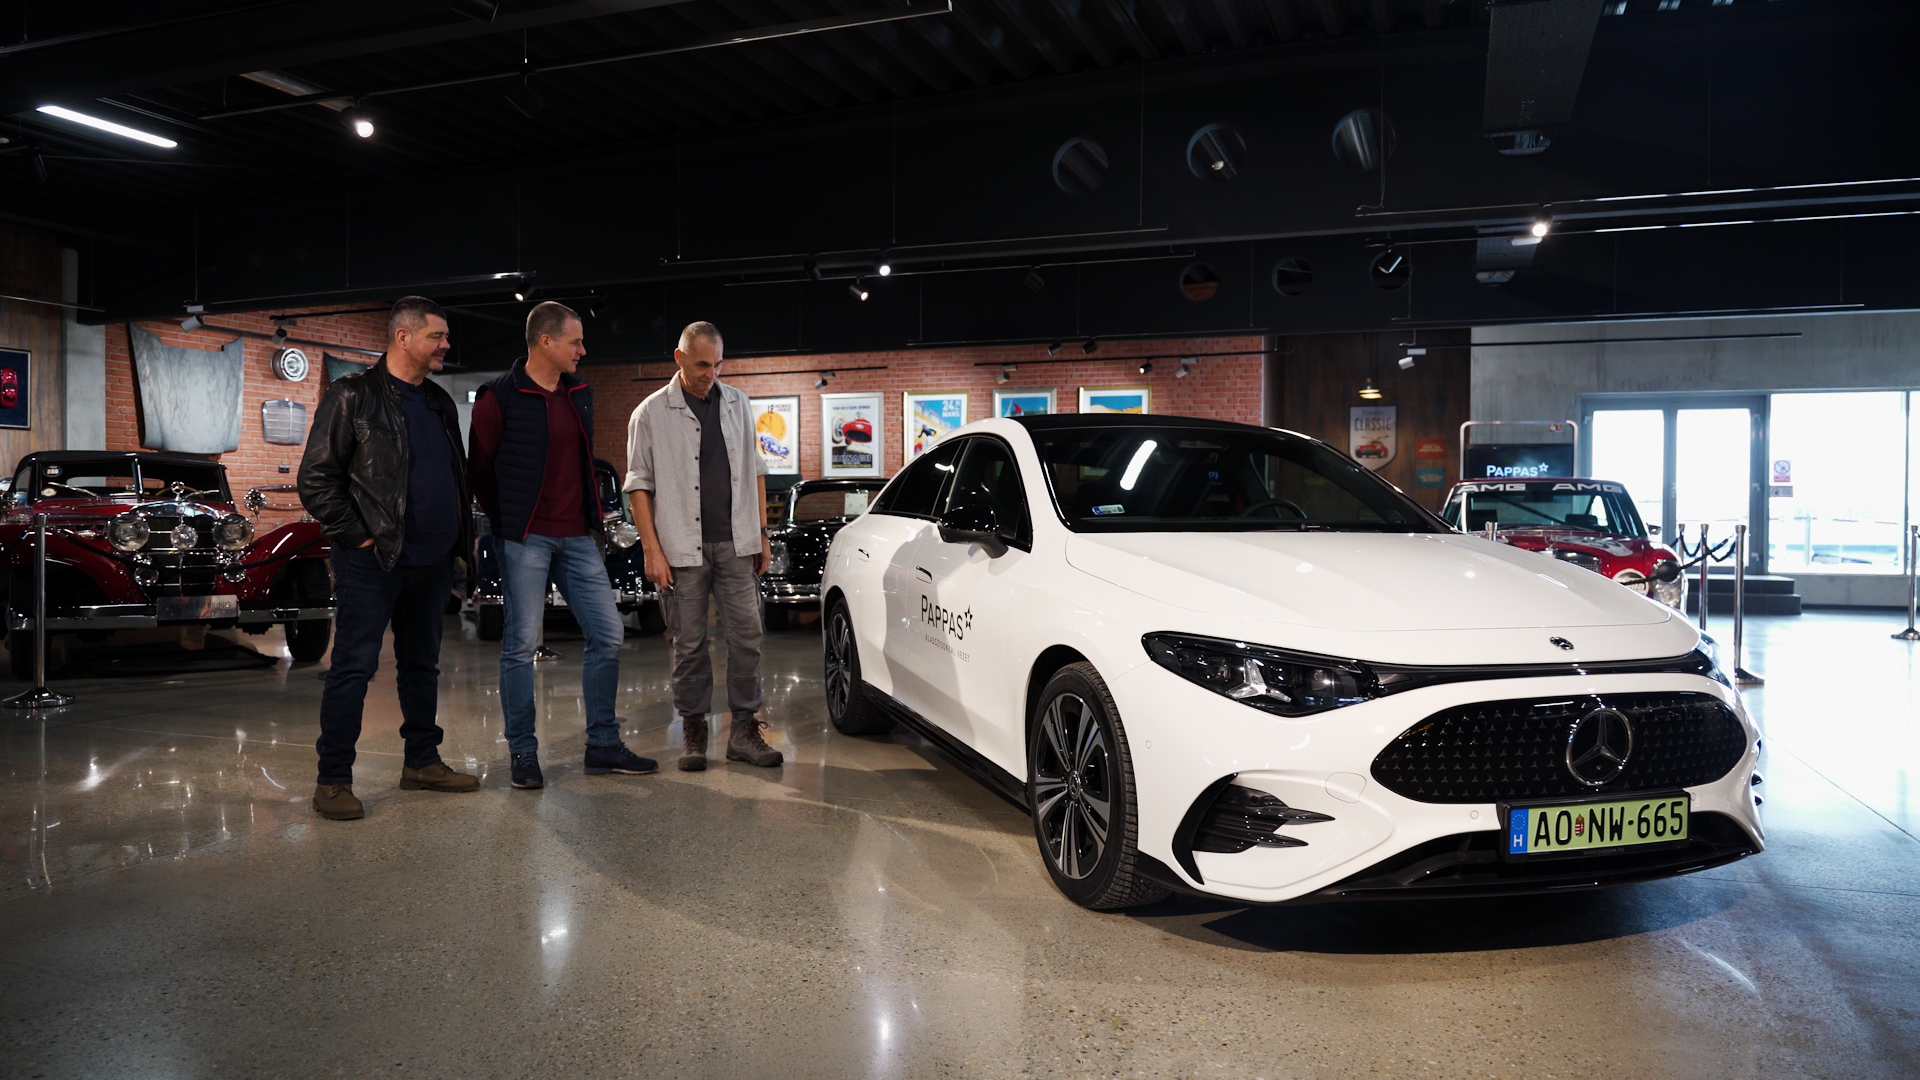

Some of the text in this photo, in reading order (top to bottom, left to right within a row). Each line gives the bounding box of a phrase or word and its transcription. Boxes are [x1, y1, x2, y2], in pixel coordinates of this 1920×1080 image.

[942, 400, 954, 410] 24
[1354, 418, 1392, 431] CLASSIC
[1486, 465, 1538, 477] PAPPAS
[1456, 484, 1526, 494] AMG
[1552, 484, 1623, 494] AMG
[922, 594, 964, 640] PAPPAS
[1513, 834, 1523, 847] H
